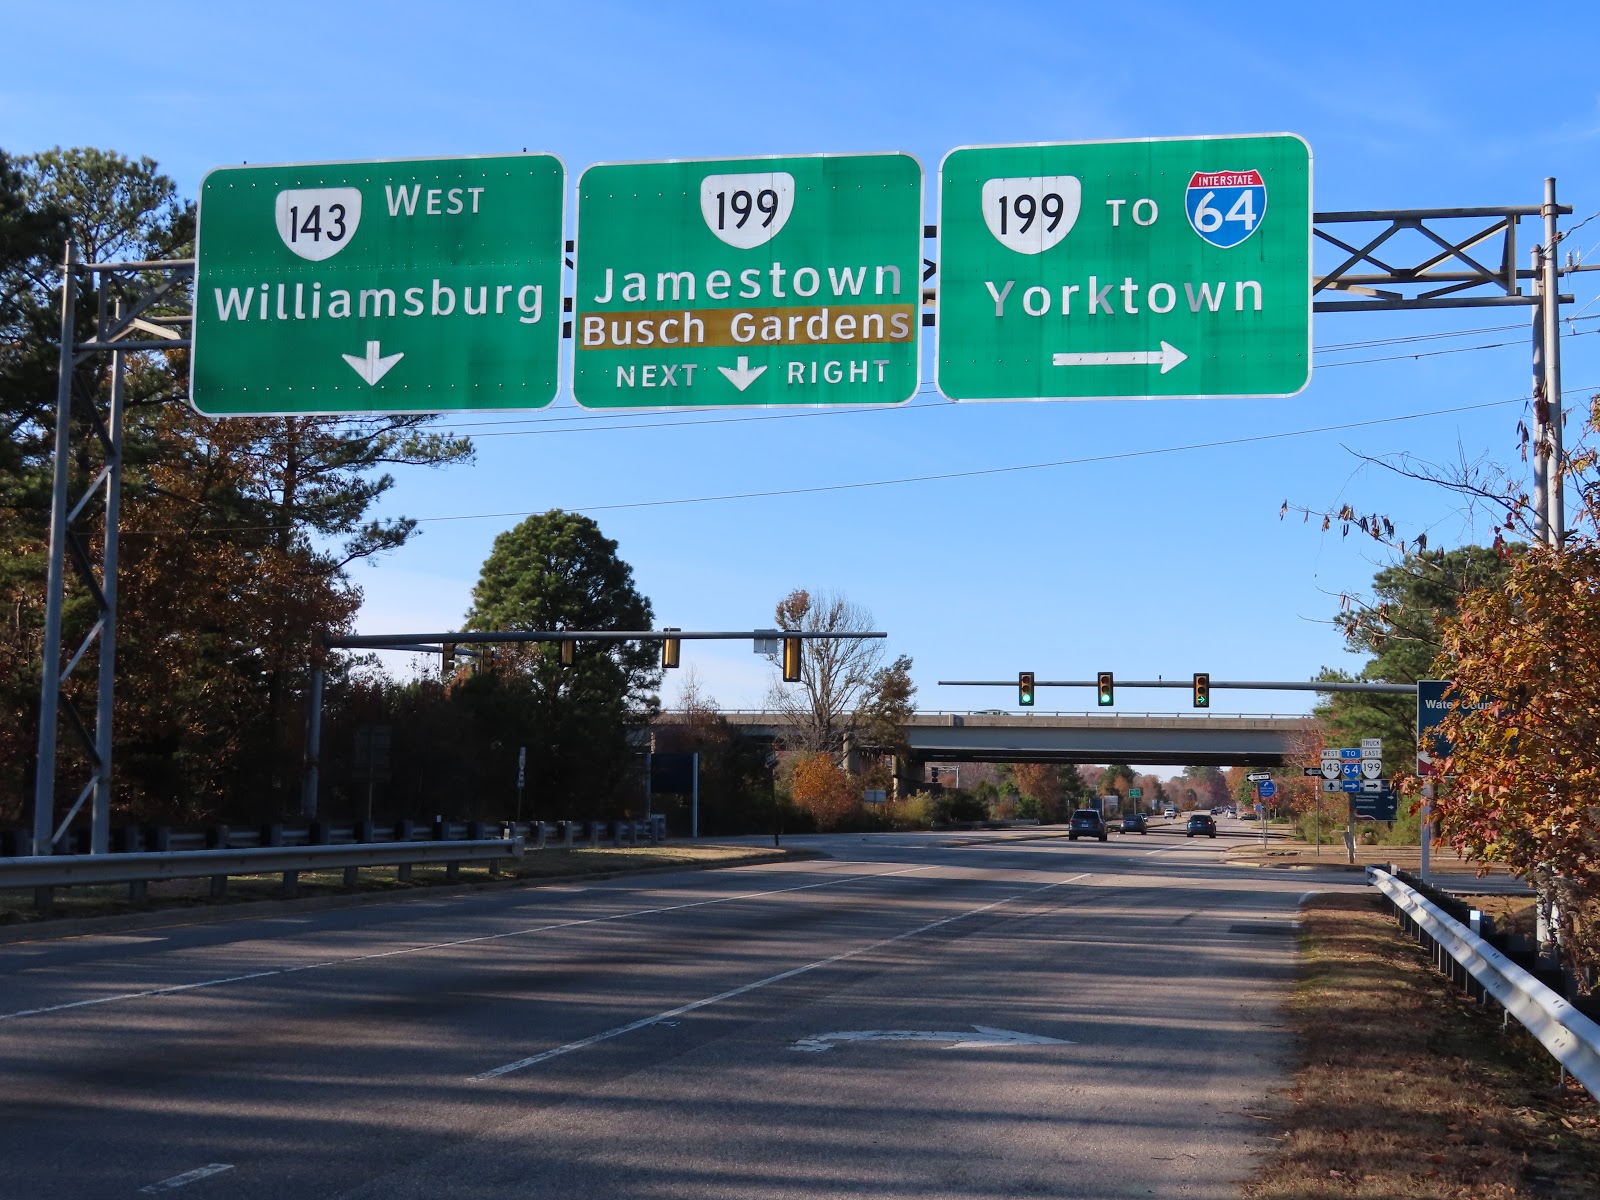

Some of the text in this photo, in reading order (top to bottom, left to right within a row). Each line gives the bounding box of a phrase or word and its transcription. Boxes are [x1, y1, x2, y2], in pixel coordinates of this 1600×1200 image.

[1198, 175, 1254, 186] INTERSTATE
[290, 184, 485, 243] 143 WEST
[716, 189, 779, 230] 199
[998, 193, 1159, 235] 199 TO
[1194, 189, 1257, 233] 64
[214, 279, 543, 324] Williamsburg
[594, 262, 901, 304] Jamestown
[984, 275, 1263, 317] Yorktown
[583, 308, 910, 347] Busch Gardens
[616, 360, 890, 388] NEXT RIGHT
[1425, 700, 1457, 709] Wate
[1322, 763, 1340, 773] 143
[1343, 764, 1359, 774] 64
[1362, 762, 1380, 772] 199
